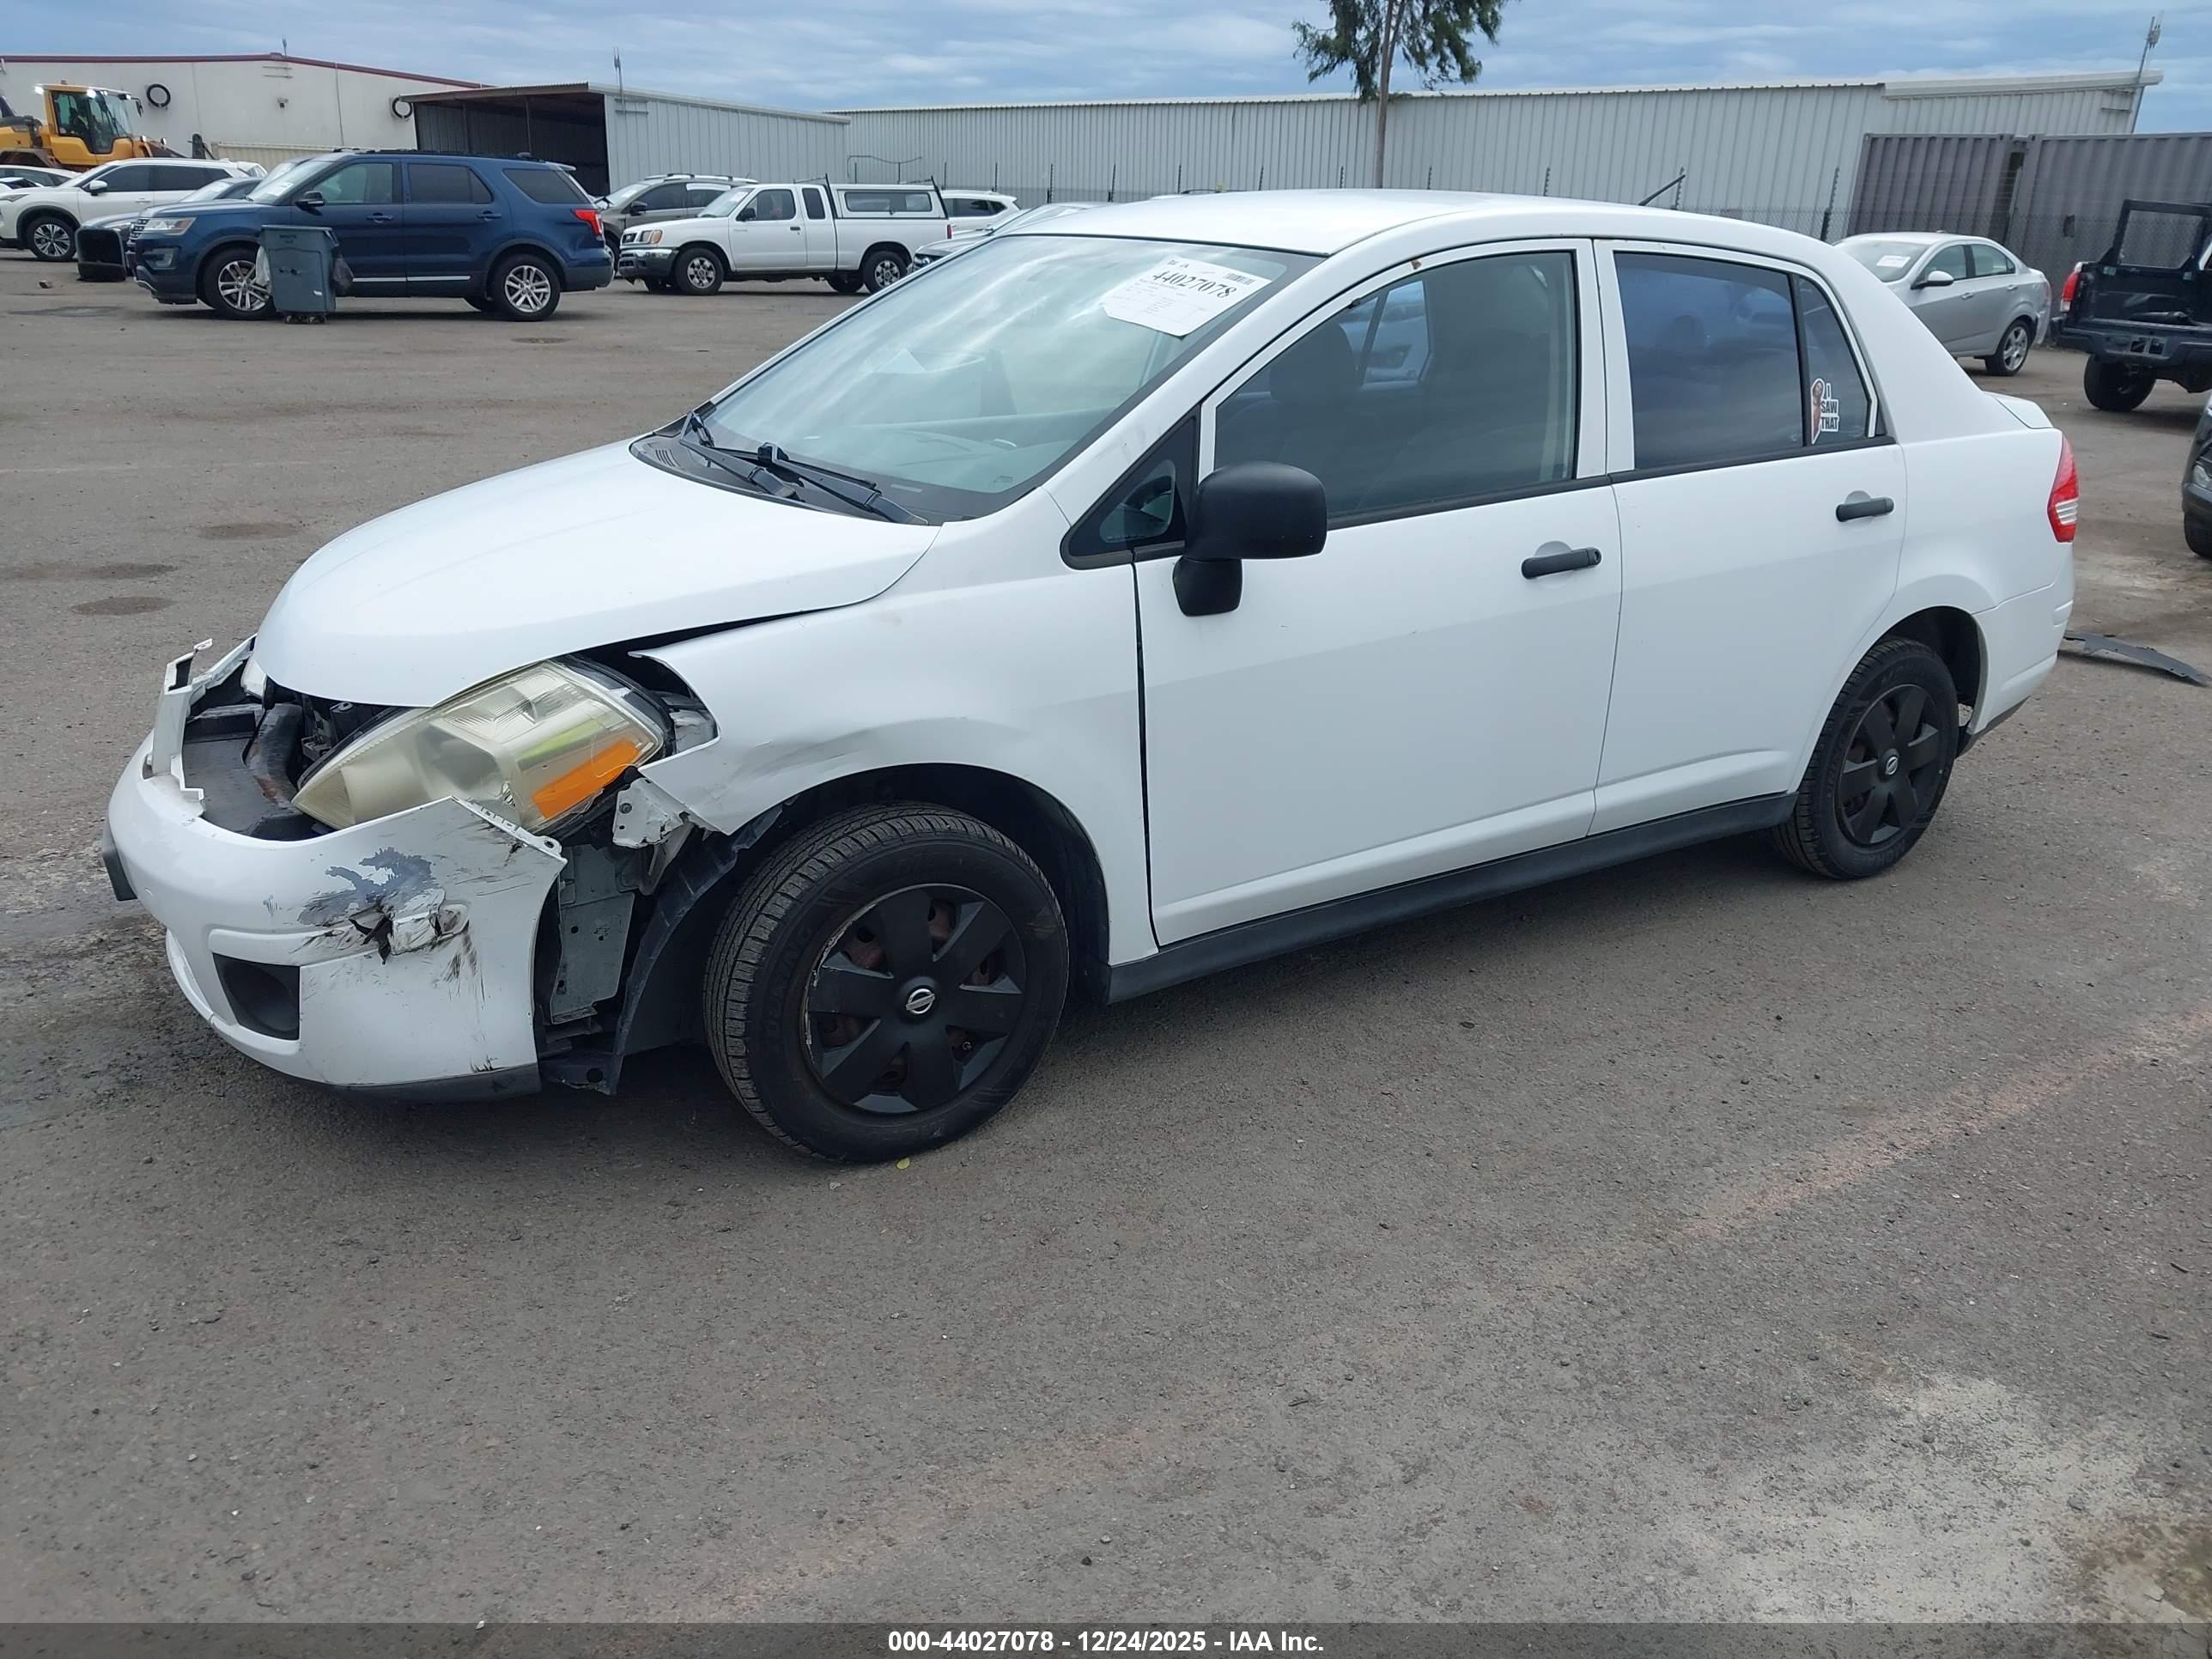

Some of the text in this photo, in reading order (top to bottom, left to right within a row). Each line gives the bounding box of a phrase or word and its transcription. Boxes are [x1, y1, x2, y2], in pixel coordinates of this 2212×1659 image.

[1152, 270, 1237, 299] 44027078
[1820, 400, 1838, 414] SAW
[1820, 416, 1838, 429] THAT
